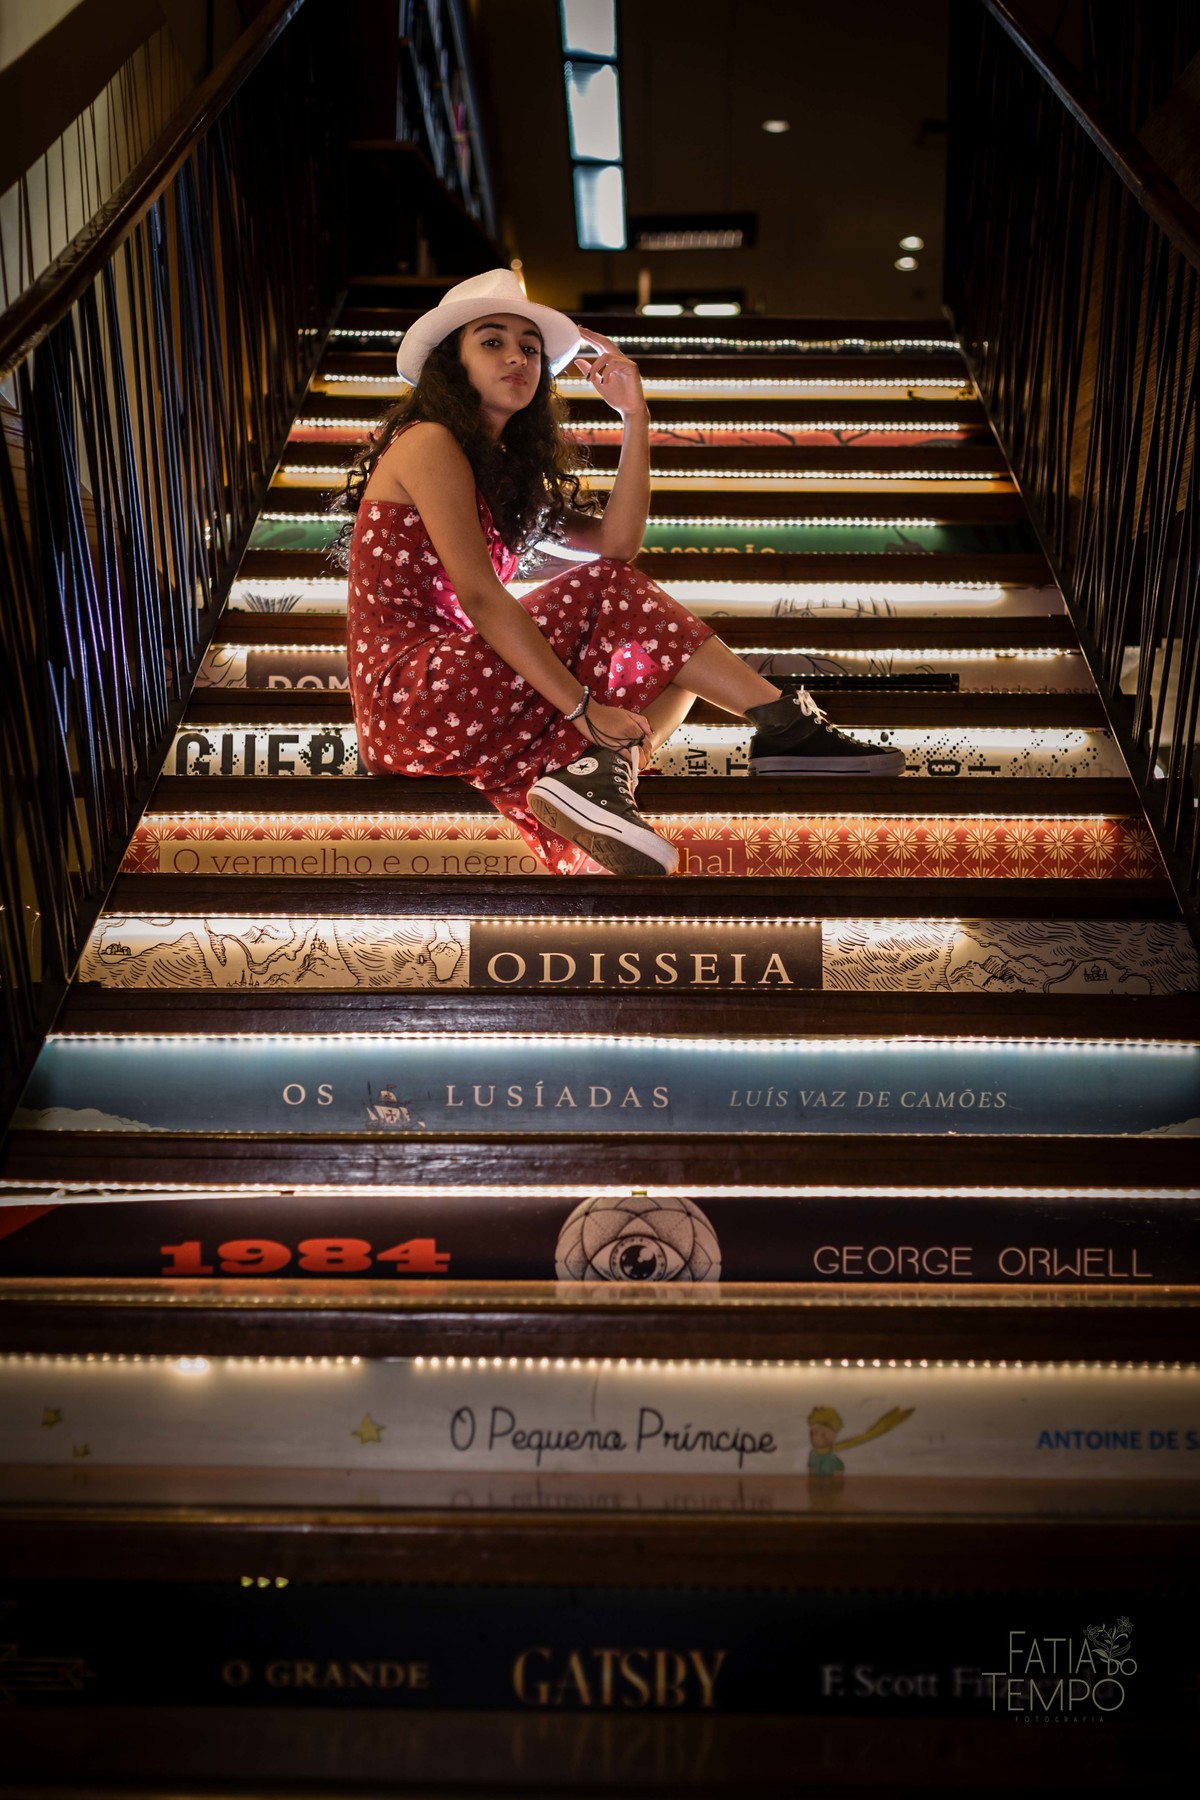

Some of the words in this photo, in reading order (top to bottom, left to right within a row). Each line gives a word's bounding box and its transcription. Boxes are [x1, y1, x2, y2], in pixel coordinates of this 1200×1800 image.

[173, 848, 200, 873] O
[210, 848, 373, 873] vermelho
[382, 854, 401, 873] e
[411, 854, 430, 873] o
[440, 854, 537, 874] negro
[487, 952, 794, 984] ODISSEIA
[282, 1083, 334, 1106] OS
[445, 1080, 670, 1109] LUSÍADAS
[730, 1086, 789, 1107] LUÍS
[799, 1090, 847, 1107] VAZ
[856, 1091, 891, 1108] DE
[900, 1088, 1008, 1109] CAMÕES
[161, 1238, 451, 1275] 1984
[813, 1246, 973, 1276] GEORGE
[998, 1247, 1153, 1277] ORWELL
[450, 1405, 476, 1451] O
[636, 1406, 778, 1469] Príncipe
[1037, 1429, 1143, 1451] ANTOINE
[1149, 1430, 1179, 1451] DE
[221, 1660, 251, 1688] O
[266, 1660, 430, 1689] GRANDE
[512, 1647, 727, 1707] GATSBY
[853, 1664, 940, 1698] Scott
